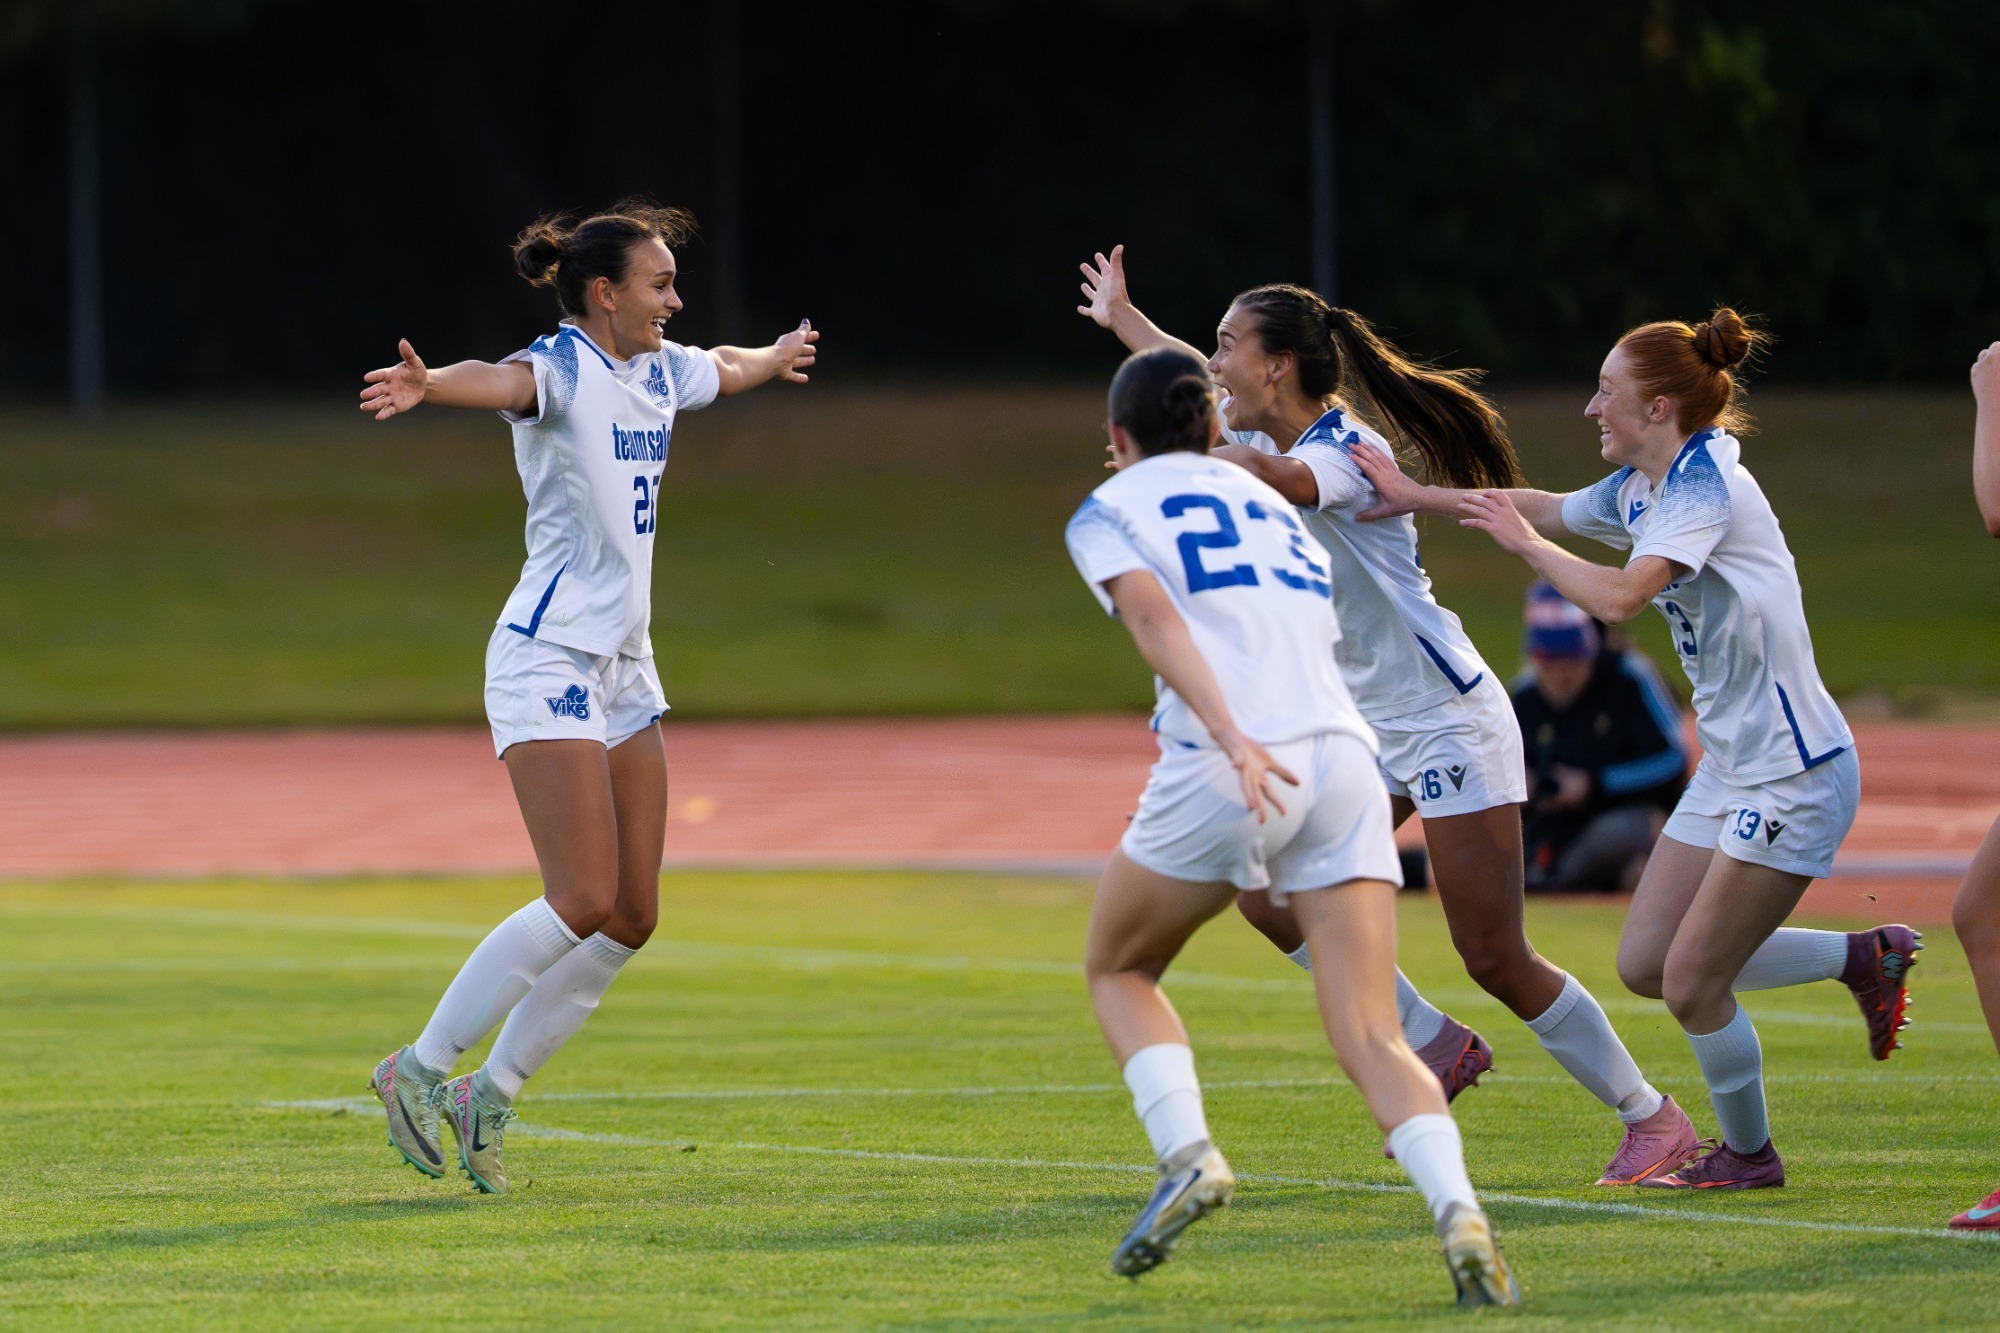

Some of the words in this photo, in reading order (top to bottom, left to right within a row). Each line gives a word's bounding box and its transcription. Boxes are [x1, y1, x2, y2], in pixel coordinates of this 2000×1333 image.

[639, 377, 669, 400] Vikes
[654, 398, 671, 409] OCCER
[1160, 494, 1331, 598] 23
[543, 697, 590, 721] Vikes
[1732, 808, 1761, 840] 13
